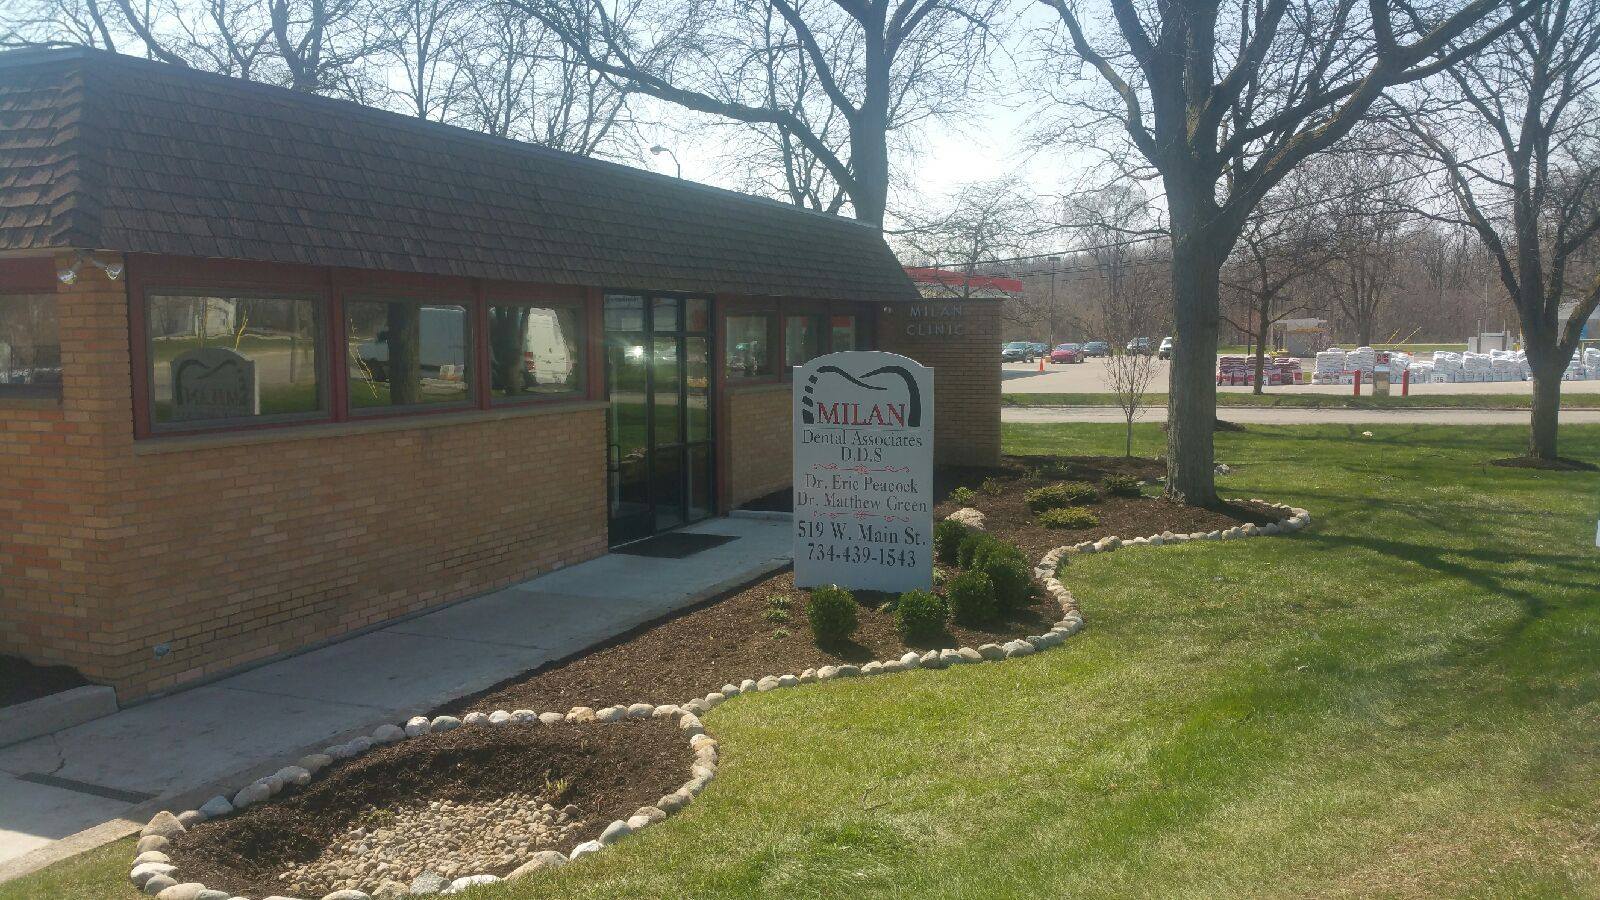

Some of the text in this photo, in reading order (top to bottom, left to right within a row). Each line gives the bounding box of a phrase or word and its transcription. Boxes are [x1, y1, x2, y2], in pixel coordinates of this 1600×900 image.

[910, 304, 962, 317] MILAN
[906, 323, 965, 336] CLINIC
[816, 401, 906, 428] MILAN
[802, 429, 923, 447] Dental Associates
[805, 473, 919, 494] Dr. Eric Peacock
[797, 491, 928, 513] Dr. Matthew Green
[798, 520, 927, 546] 519 W. Main St.
[807, 542, 917, 568] 734-439-1543
